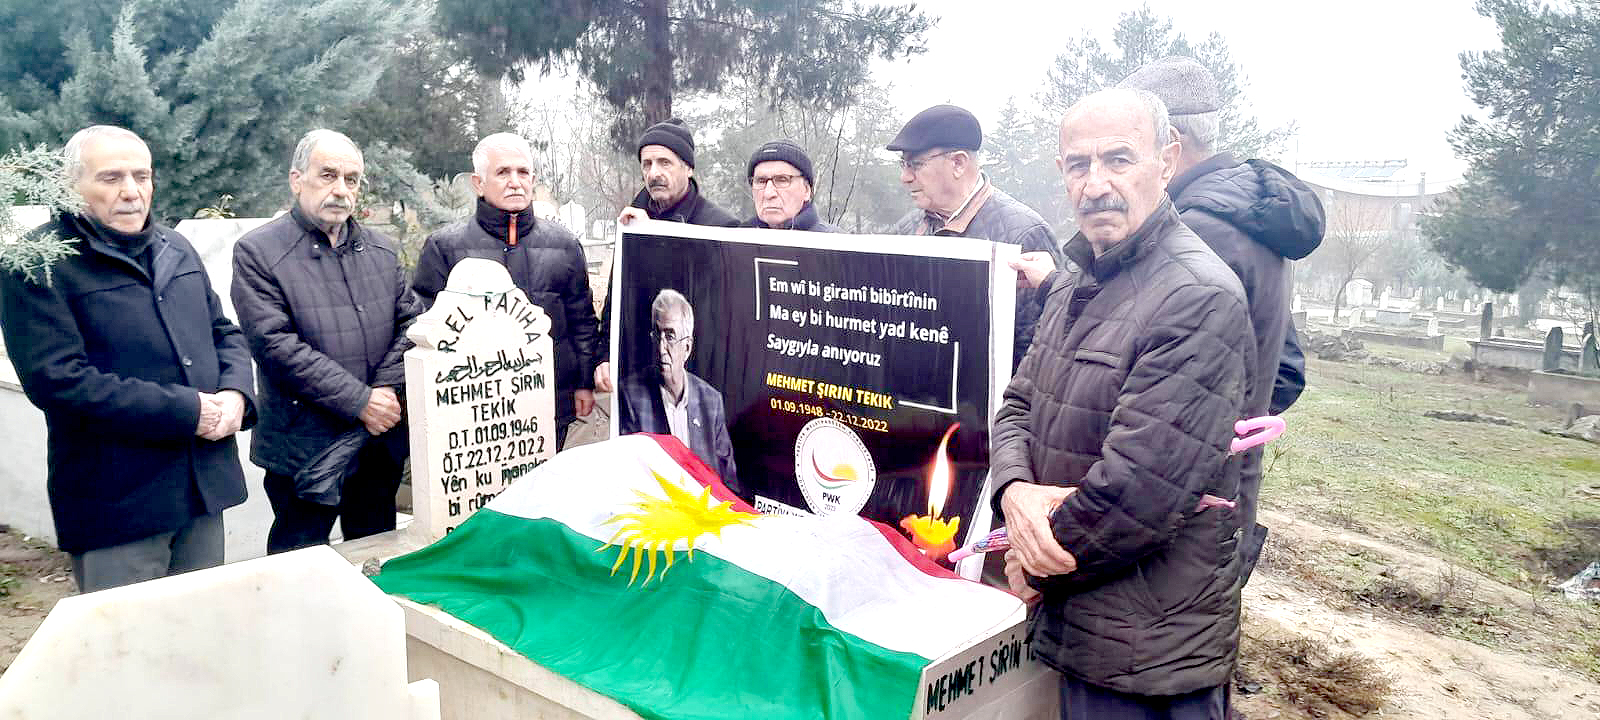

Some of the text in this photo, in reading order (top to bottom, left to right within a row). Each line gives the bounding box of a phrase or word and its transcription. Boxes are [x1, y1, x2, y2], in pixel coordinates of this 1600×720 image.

[769, 277, 938, 311] Em wî bi giramî bibîrtînin
[769, 304, 950, 344] Ma ey bi hurmet yad kenê
[767, 333, 881, 367] Saygıyla anıyoruz
[436, 379, 502, 407] MEHMET
[766, 372, 816, 394] MEHMET
[856, 389, 894, 410] TEKIK
[770, 397, 824, 418] 01.09.1948
[831, 409, 889, 433] 22.12.2022
[440, 475, 468, 496] Yên
[475, 469, 492, 489] ku
[822, 492, 841, 505] PWK
[448, 496, 461, 517] bi
[926, 655, 985, 715] MEHMET
